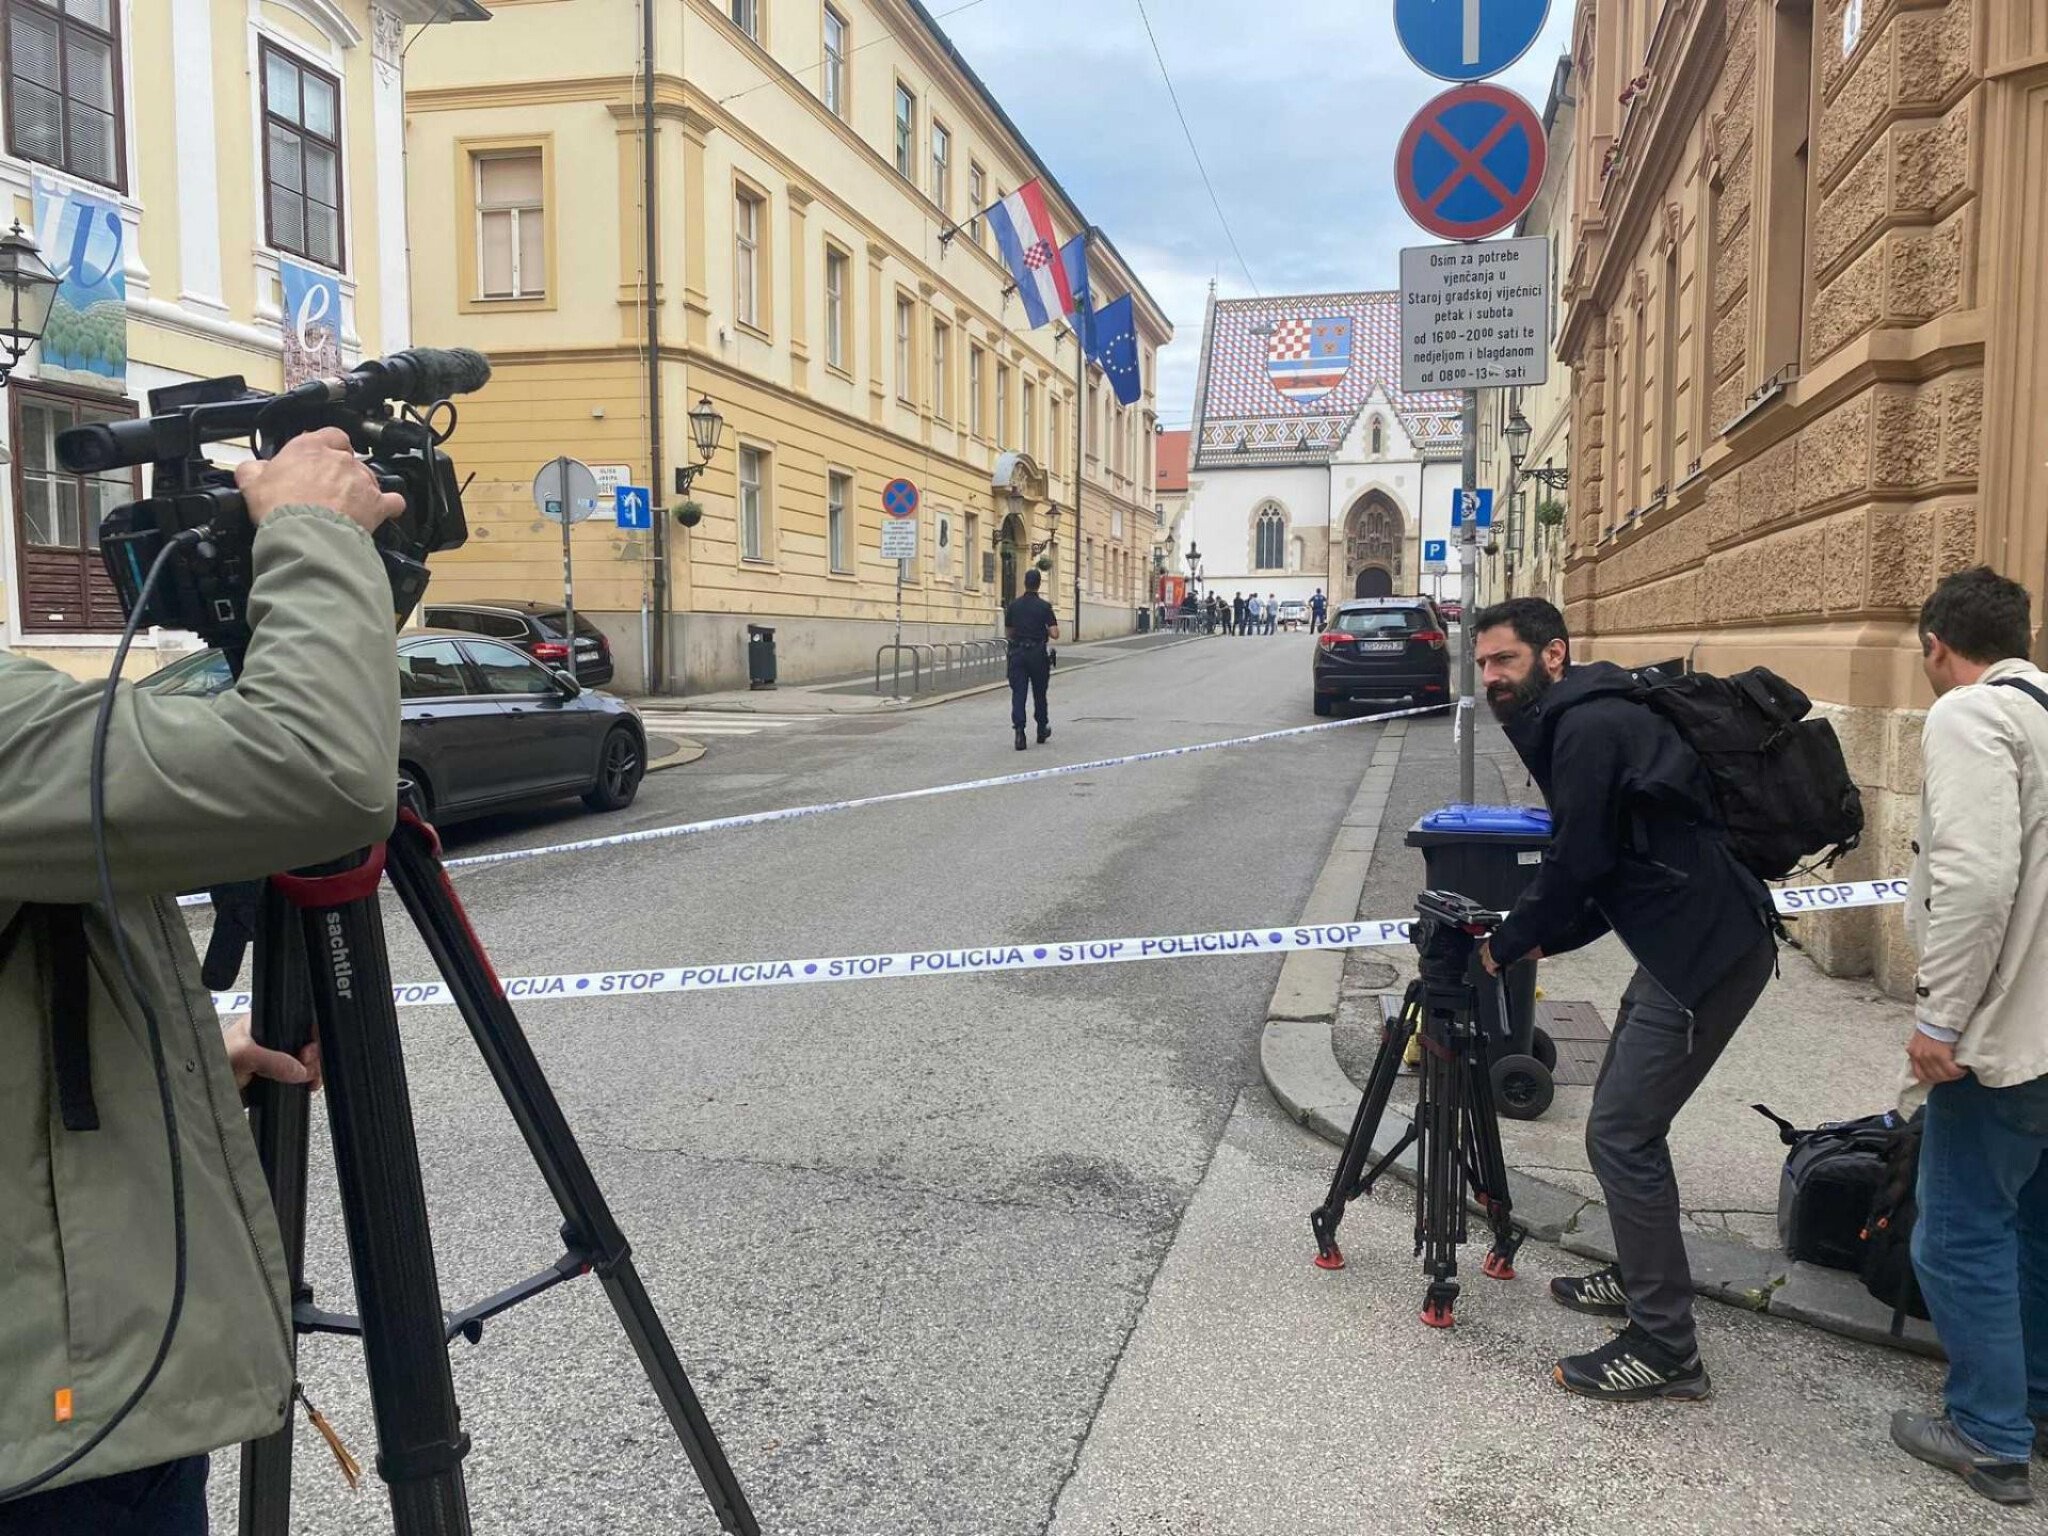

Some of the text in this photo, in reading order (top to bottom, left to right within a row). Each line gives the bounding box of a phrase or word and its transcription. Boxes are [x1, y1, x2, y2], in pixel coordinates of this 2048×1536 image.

[1430, 249, 1520, 267] Osim za potrebe
[1443, 269, 1506, 287] vjenčanja u
[1408, 284, 1542, 305] Staroj gradskoj vijećnici
[1434, 306, 1514, 324] petak i subota
[1414, 332, 1426, 344] od
[1497, 327, 1519, 340] sati
[1523, 326, 1535, 338] te
[1413, 346, 1534, 364] nedjeljom i blagdanom
[1421, 371, 1433, 383] od
[1504, 366, 1526, 379] sati
[1430, 544, 1440, 557] P
[1783, 885, 1855, 908] STOP
[326, 912, 353, 1000] sachtler
[393, 985, 440, 1003] TOP
[504, 977, 565, 996] ICIJA
[600, 971, 666, 993] STOP
[681, 962, 796, 985] POLICIJA
[828, 955, 894, 978] STOP
[909, 946, 1025, 972] POLICIJA
[1057, 940, 1125, 962] STOP
[1140, 930, 1260, 956] POLICIJA
[1293, 924, 1363, 947] STOP
